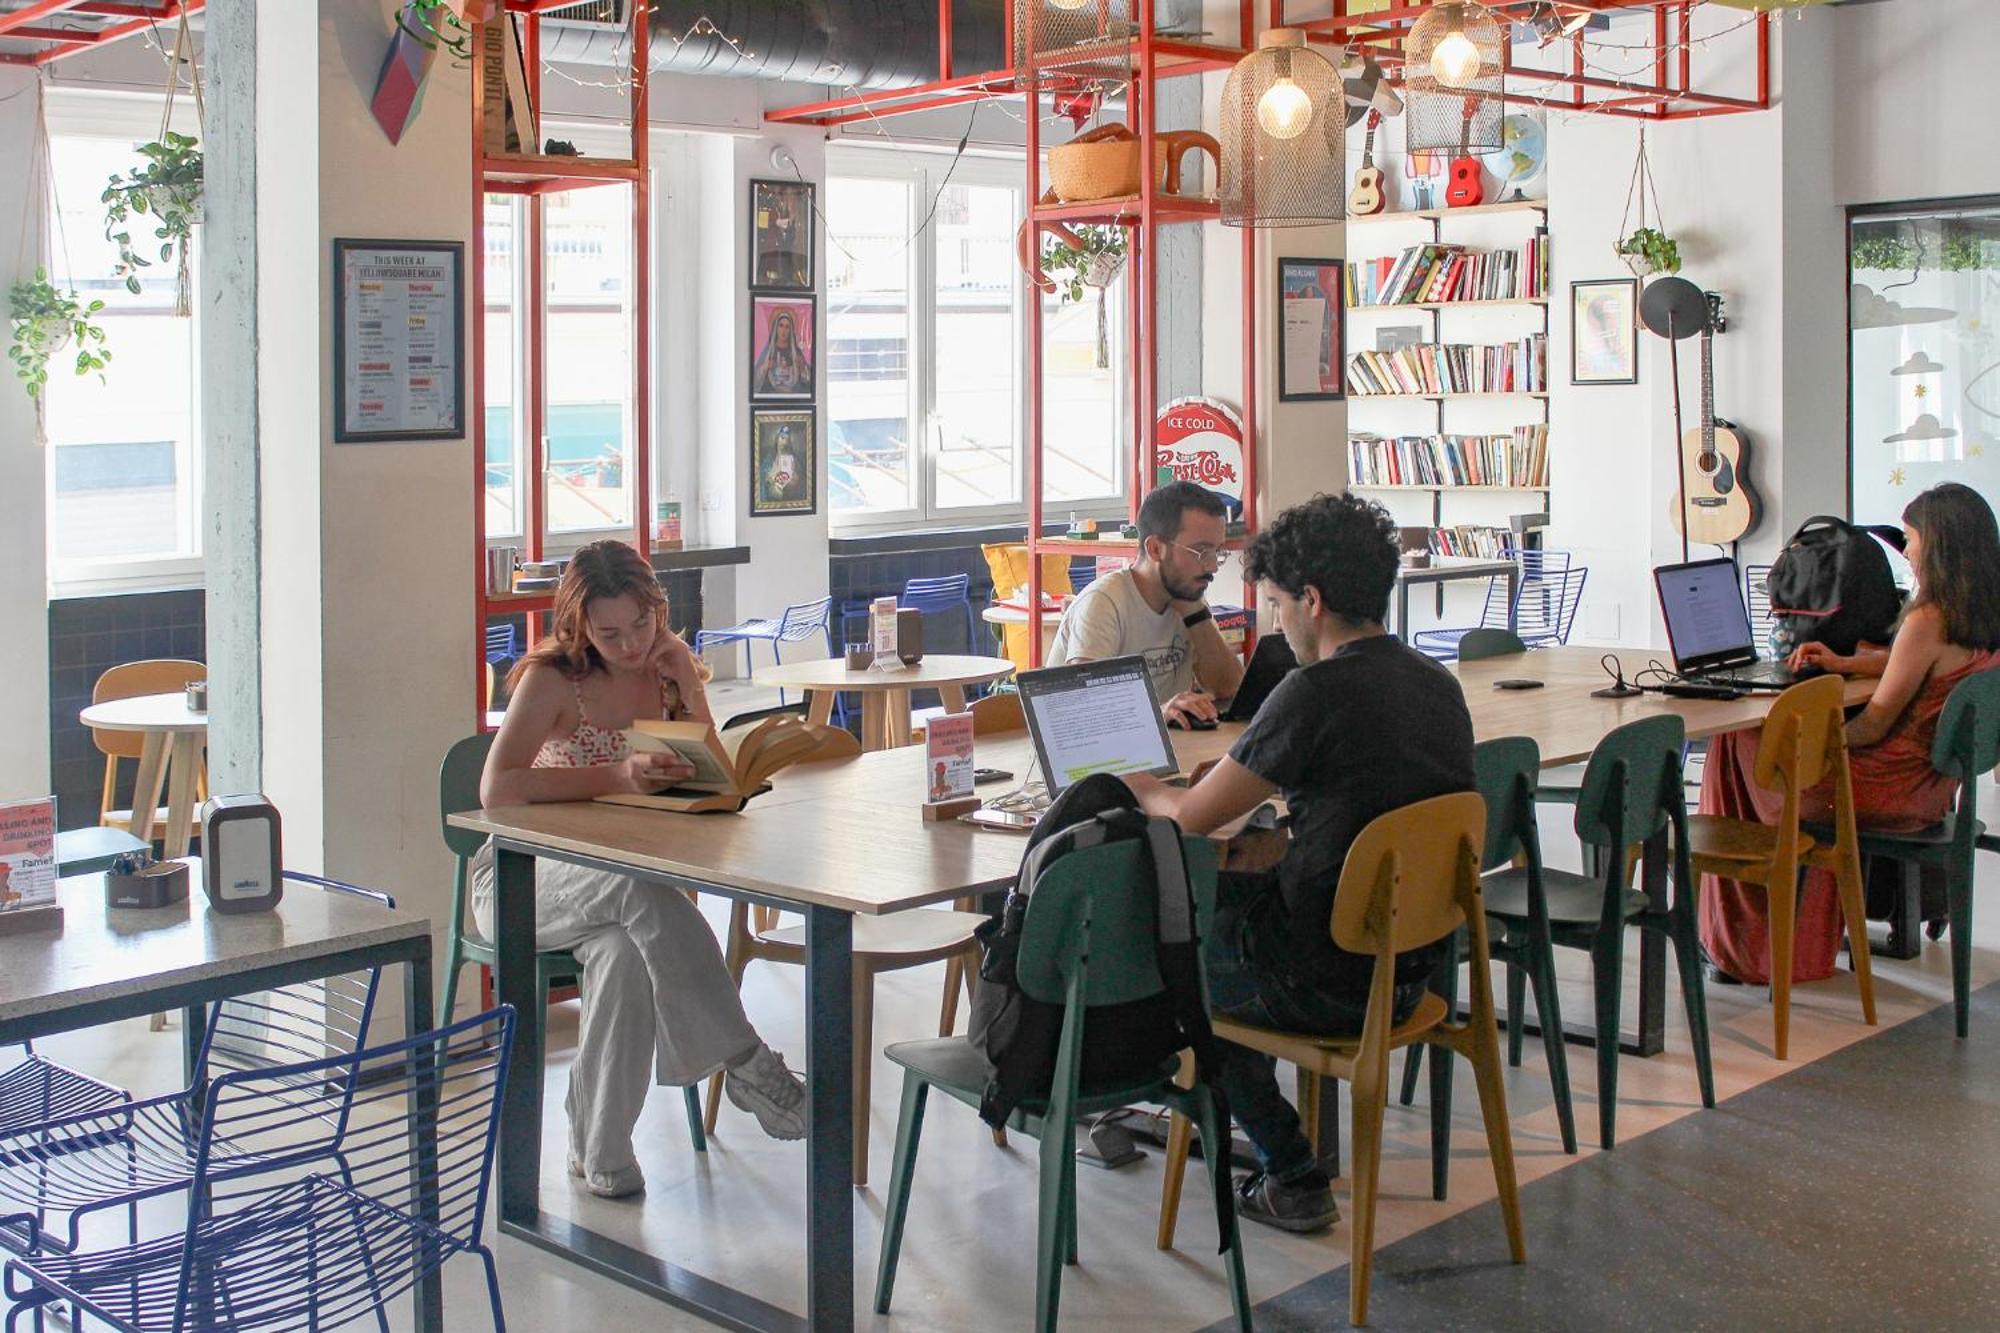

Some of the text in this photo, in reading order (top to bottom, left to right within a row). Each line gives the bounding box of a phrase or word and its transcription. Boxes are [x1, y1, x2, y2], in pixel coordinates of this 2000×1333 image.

[485, 26, 503, 101] GIO PONTI
[374, 255, 426, 266] THIS WEEK AT
[1167, 417, 1215, 430] ICE COLD
